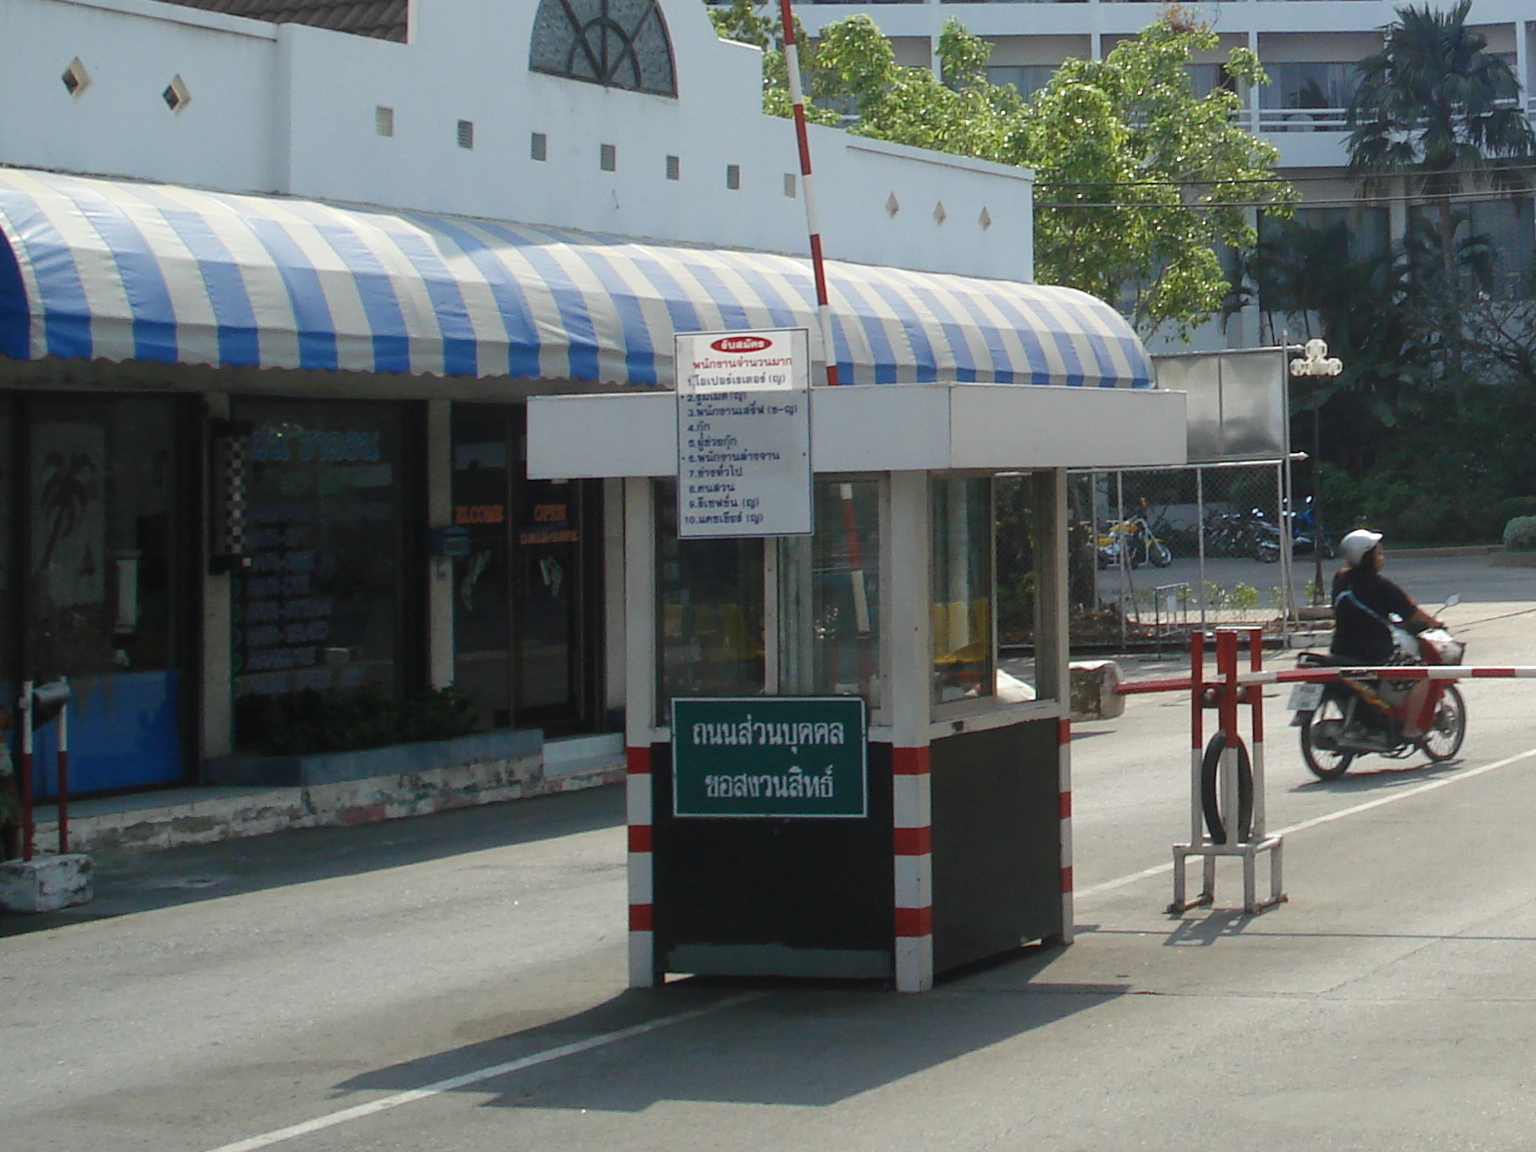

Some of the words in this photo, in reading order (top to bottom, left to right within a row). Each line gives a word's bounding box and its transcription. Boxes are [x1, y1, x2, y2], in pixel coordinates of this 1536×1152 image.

[692, 713, 844, 755] ถนนส่วนบุคคล
